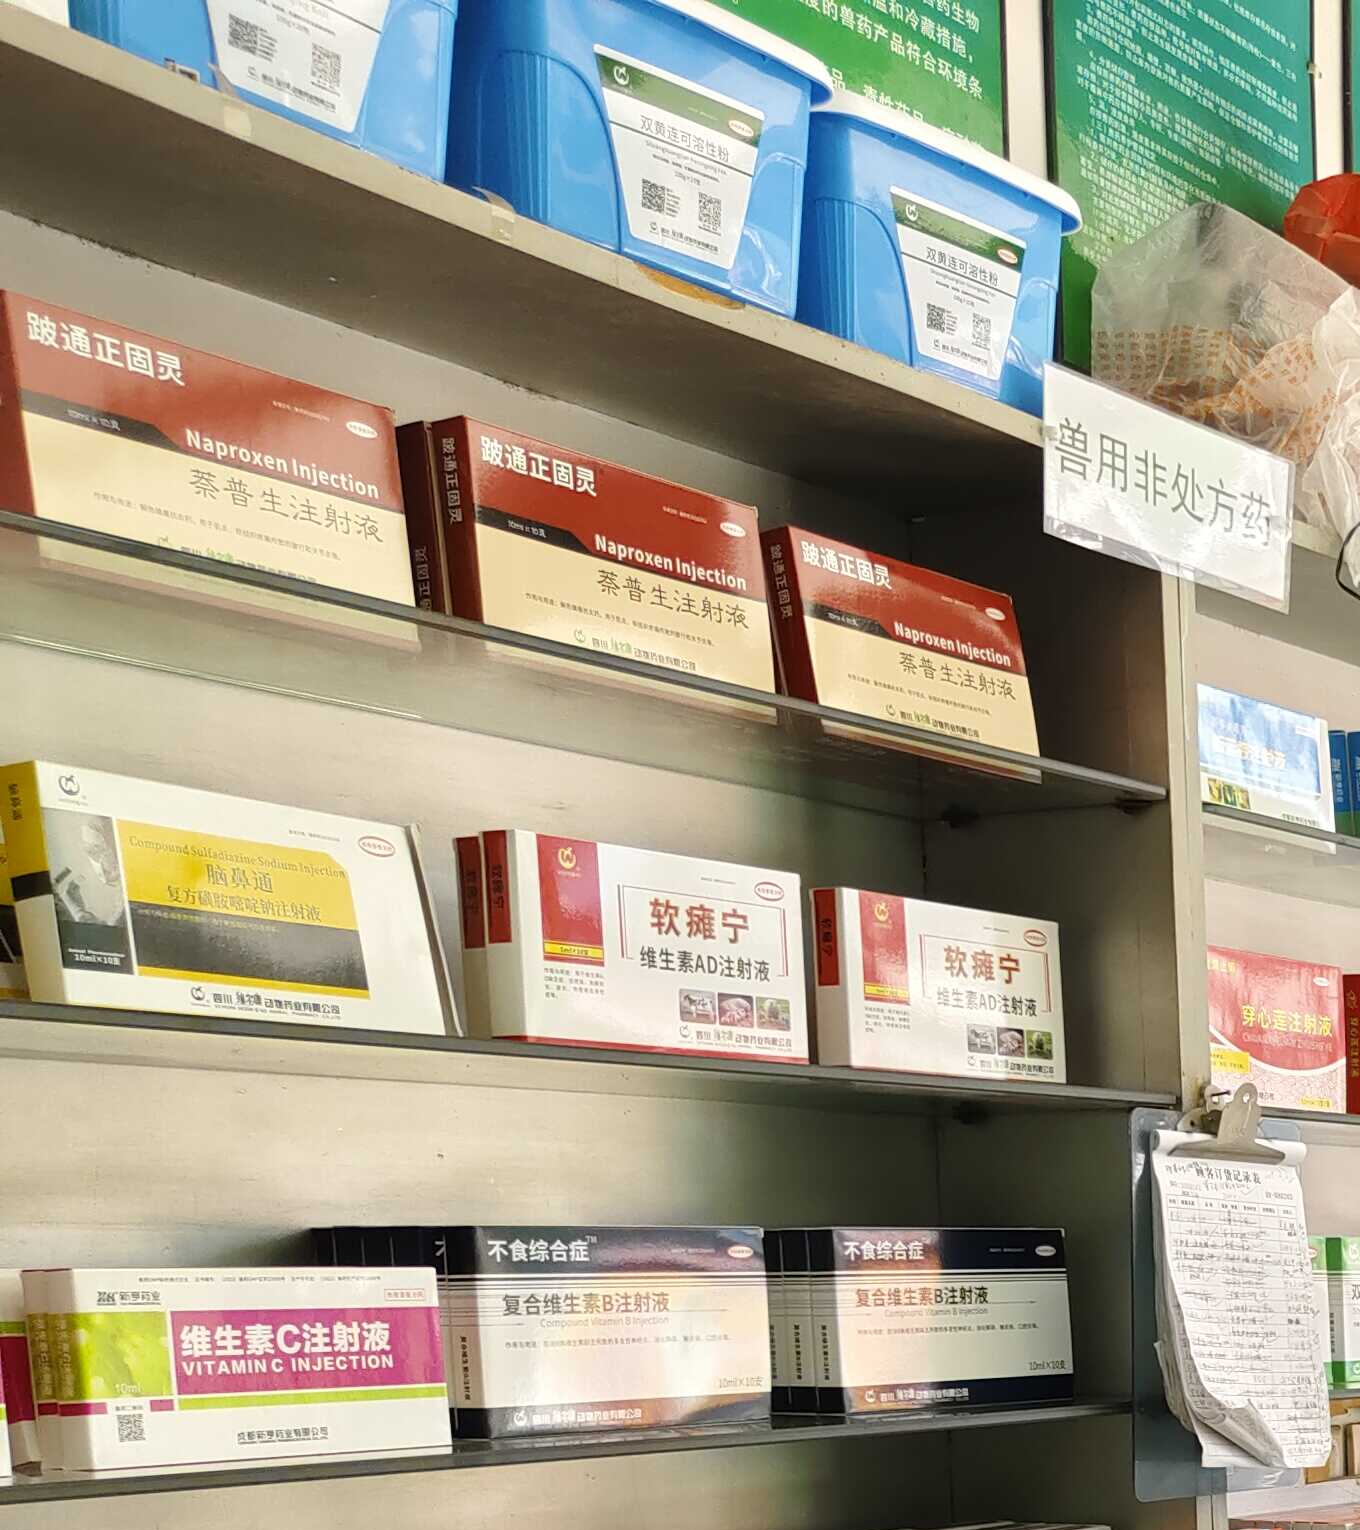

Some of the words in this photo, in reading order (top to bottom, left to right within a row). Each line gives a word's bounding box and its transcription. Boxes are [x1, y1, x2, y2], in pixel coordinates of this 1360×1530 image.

[639, 114, 730, 163] 双黄连可溶性粉
[925, 245, 1000, 288] 双黄连可溶性粉
[26, 311, 186, 386] 跛通正固灵
[184, 428, 289, 474] Naproxen
[291, 457, 380, 500] Injection
[480, 435, 598, 498] 跛通正固灵
[1055, 416, 1273, 548] 兽用非处方药
[188, 468, 384, 544] 萘普生注射液
[593, 533, 674, 572] Naproxen
[675, 557, 748, 592] Injection
[799, 539, 893, 590] 跛通正固灵
[596, 569, 751, 631] 萘普生注射液
[893, 620, 956, 652] Naproxen
[955, 640, 1012, 668] Injection
[898, 651, 1017, 701] 萘普生注射液
[128, 834, 189, 857] Compound
[189, 841, 257, 866] Sulfadiazine
[257, 853, 299, 873] Sodium
[298, 860, 348, 882] Injection
[204, 862, 275, 895] 脑鼻通
[648, 897, 750, 945] 软瘫宁
[638, 944, 771, 983] 维生素AD注射液
[942, 944, 1022, 985] 软瘫宁
[936, 985, 1039, 1018] 维生素AD注射液
[1240, 1004, 1334, 1039] 穿心莲注射液
[486, 1237, 591, 1264] 不食综合症
[843, 1240, 925, 1262] 不食综合症
[502, 1291, 671, 1317] 复合维生素B注射液
[855, 1286, 989, 1309] 复合维生素B注射液
[180, 1319, 392, 1359] 维生素C注射液
[181, 1356, 268, 1377] VITAMIN
[271, 1356, 285, 1374] C
[290, 1353, 395, 1373] INJECTION
